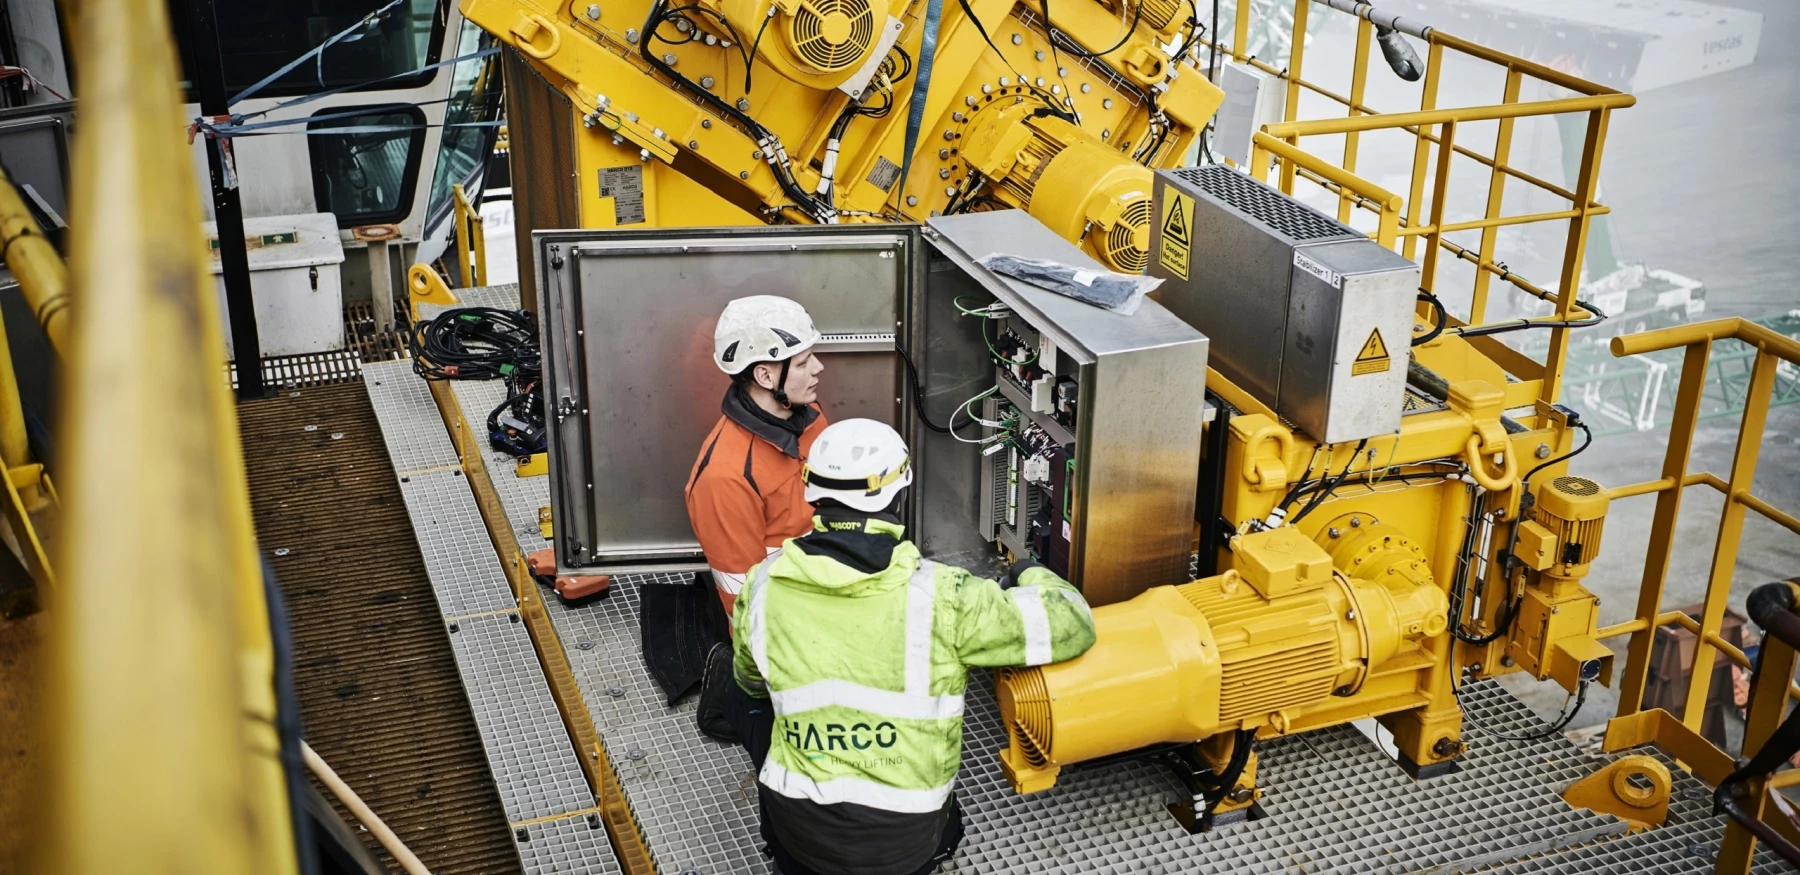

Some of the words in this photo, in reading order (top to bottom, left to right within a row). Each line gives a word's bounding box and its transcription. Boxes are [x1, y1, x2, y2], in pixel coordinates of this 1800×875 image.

[1165, 243, 1184, 260] Danger!
[1170, 257, 1186, 270] surface
[1296, 255, 1324, 276] Stabilizer
[1325, 270, 1329, 280] 1
[1333, 275, 1339, 286] 2
[784, 717, 897, 751] HARCO
[864, 755, 903, 769] LIFTING
